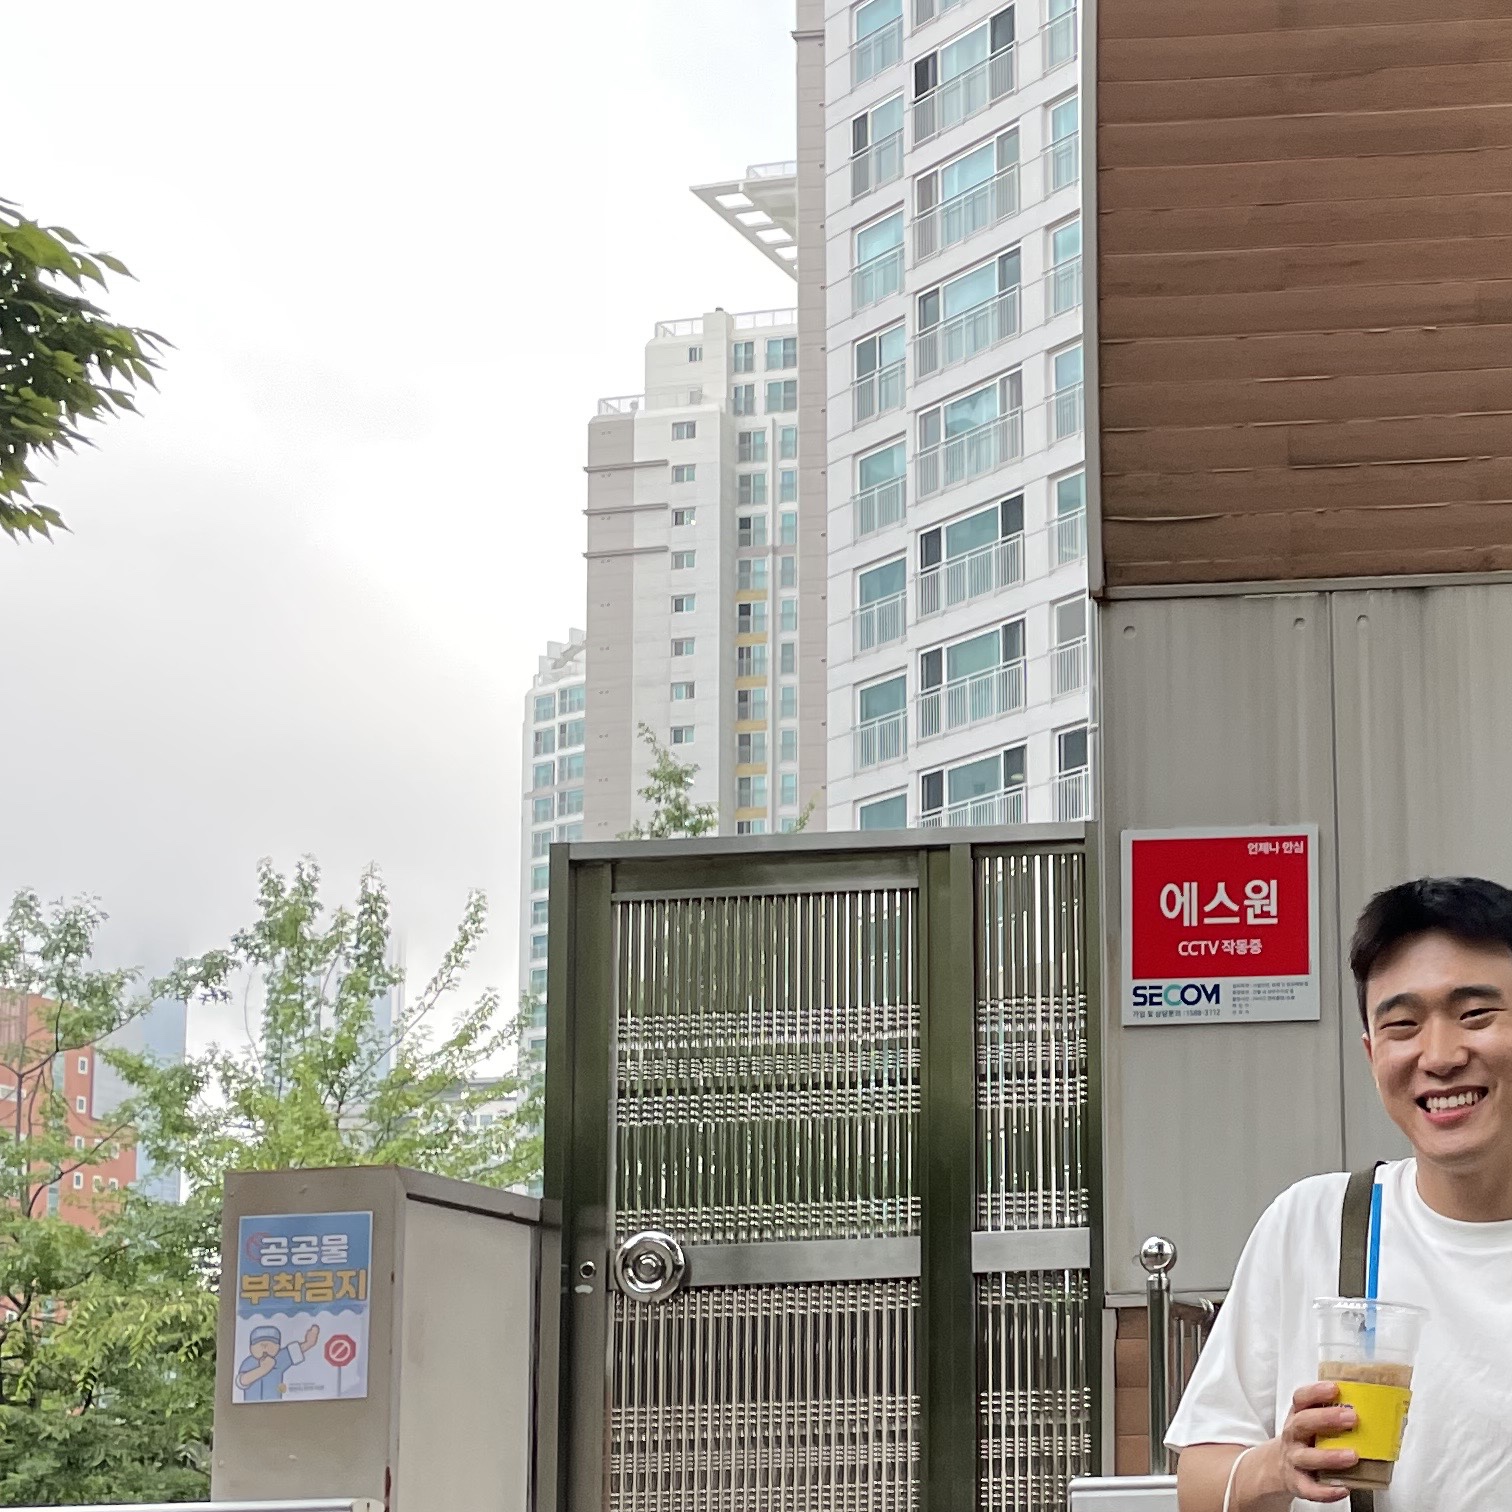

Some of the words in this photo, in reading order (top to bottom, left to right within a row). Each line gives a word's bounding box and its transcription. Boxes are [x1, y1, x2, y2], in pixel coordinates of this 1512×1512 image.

[1282, 840, 1304, 854] 안심
[1159, 879, 1279, 927] 에스원
[1178, 940, 1220, 956] CCTV
[1221, 938, 1262, 955] 작동중
[1132, 983, 1220, 1006] SECOM
[260, 1234, 349, 1266] 공공물
[240, 1269, 368, 1304] 부착금지
